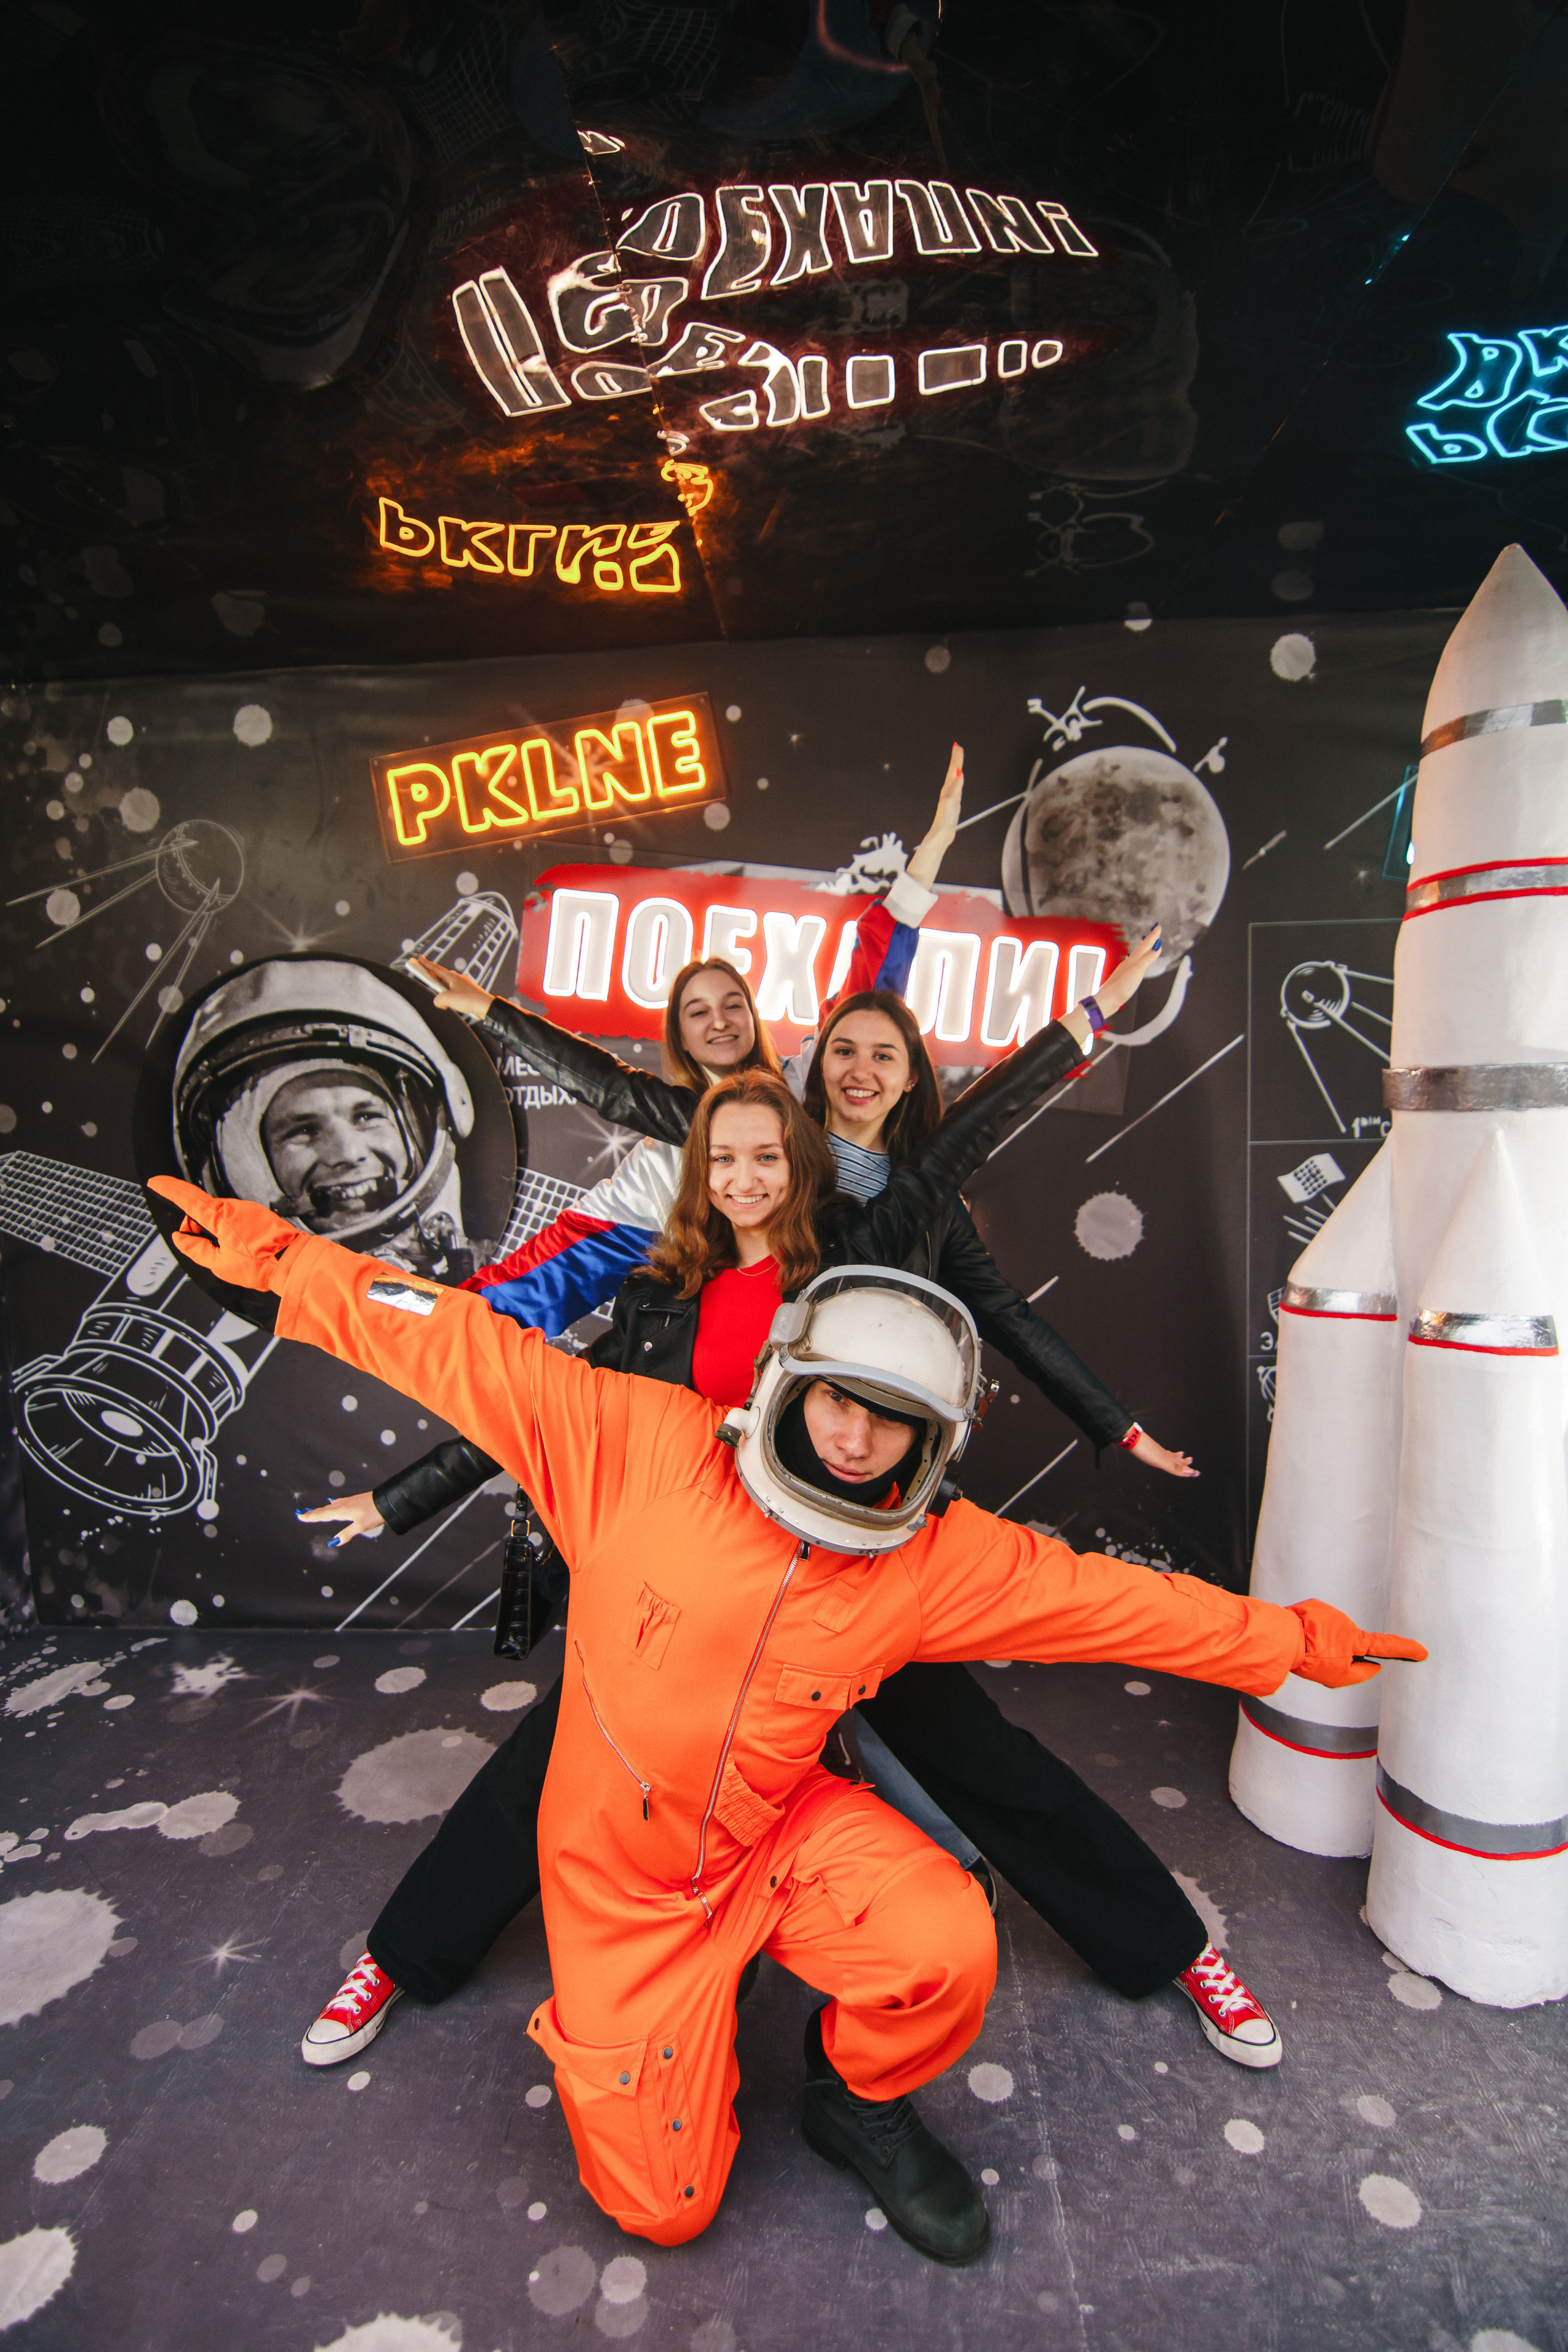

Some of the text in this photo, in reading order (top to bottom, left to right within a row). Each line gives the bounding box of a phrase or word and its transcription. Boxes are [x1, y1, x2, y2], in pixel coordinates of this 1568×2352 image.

[386, 710, 706, 845] PKLNE
[543, 888, 1107, 1056] ПОЕХЛИ!
[496, 1055, 541, 1077] МЕС
[504, 1085, 577, 1110] ОТДЫХ
